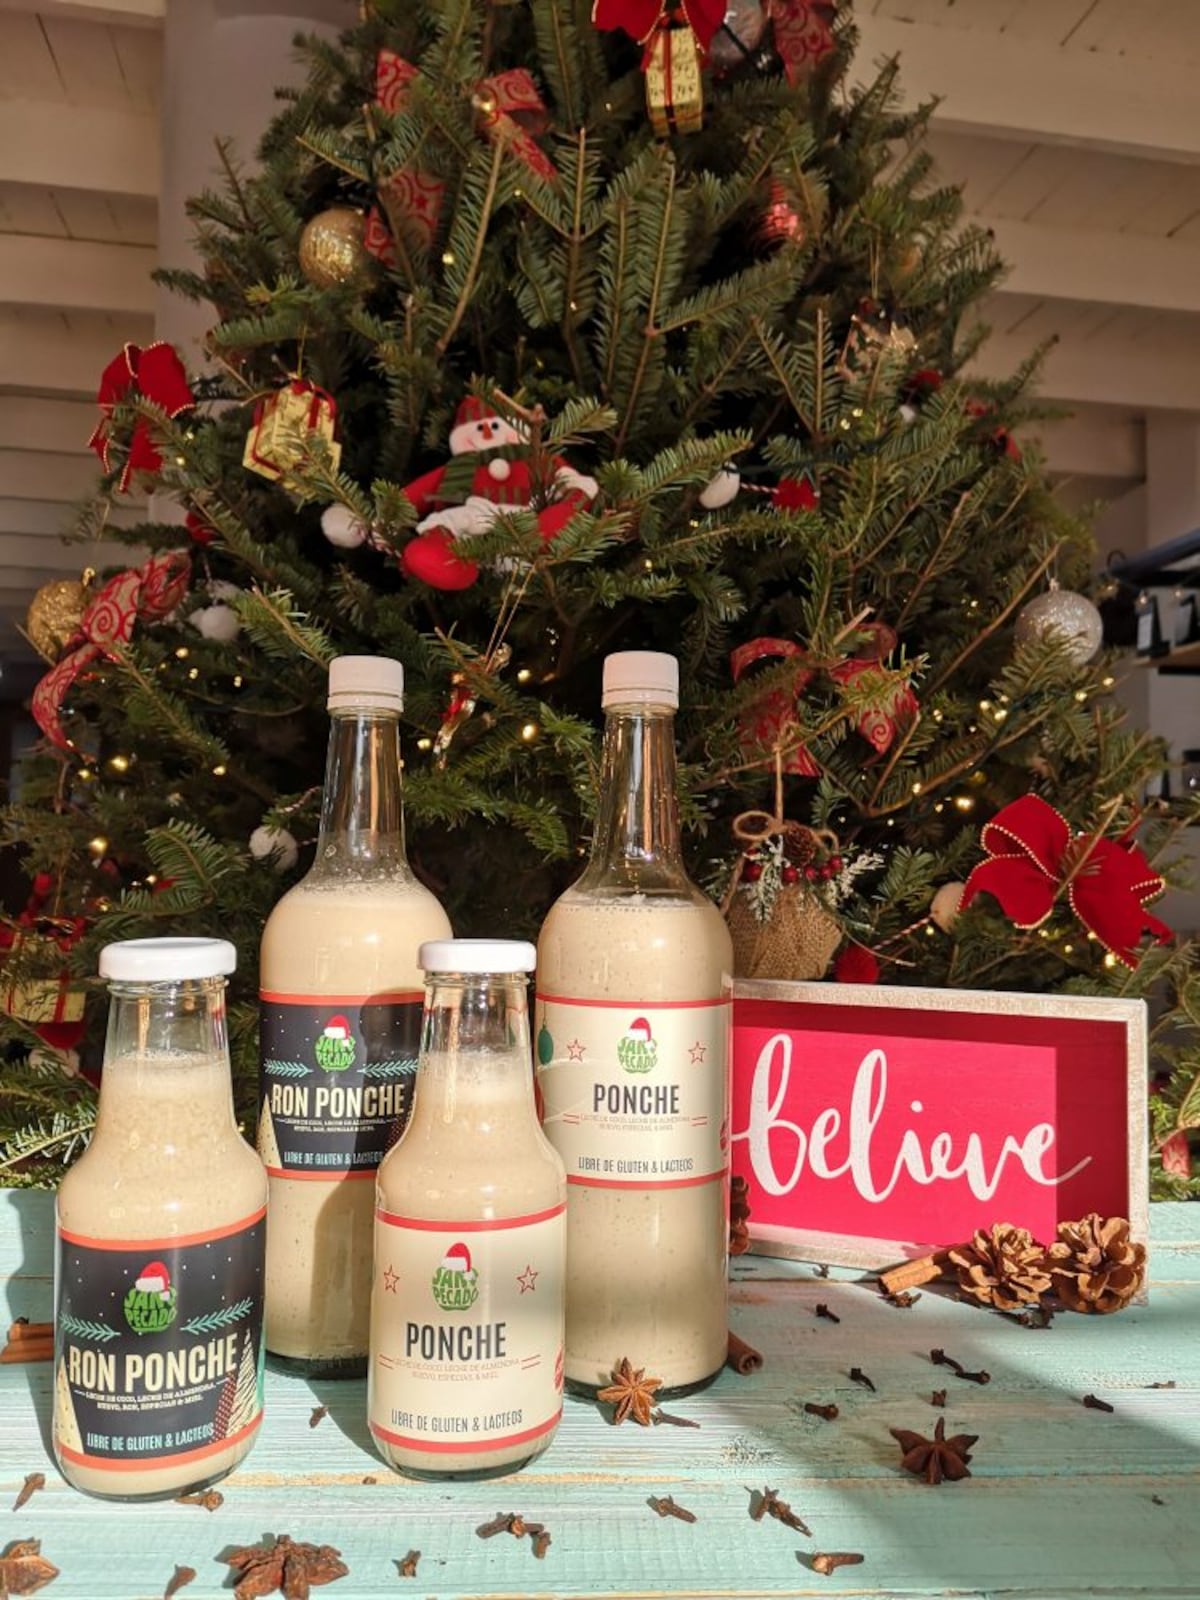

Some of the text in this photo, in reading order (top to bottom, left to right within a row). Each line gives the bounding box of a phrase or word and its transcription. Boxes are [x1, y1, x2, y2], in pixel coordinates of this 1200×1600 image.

[272, 1084, 405, 1118] RON PONCHE
[593, 1084, 679, 1114] PONCHE
[731, 1033, 1092, 1203] believe
[578, 1157, 694, 1174] LIBRE DE GLUTEN & LACTEOS
[406, 1322, 506, 1361] PONCHE
[69, 1333, 237, 1392] RON PONCHE
[392, 1408, 522, 1432] LIBRE DE GLUTEN & LACTEOS
[87, 1422, 214, 1451] LIBRE DE GLUTEN & LACTEOS
